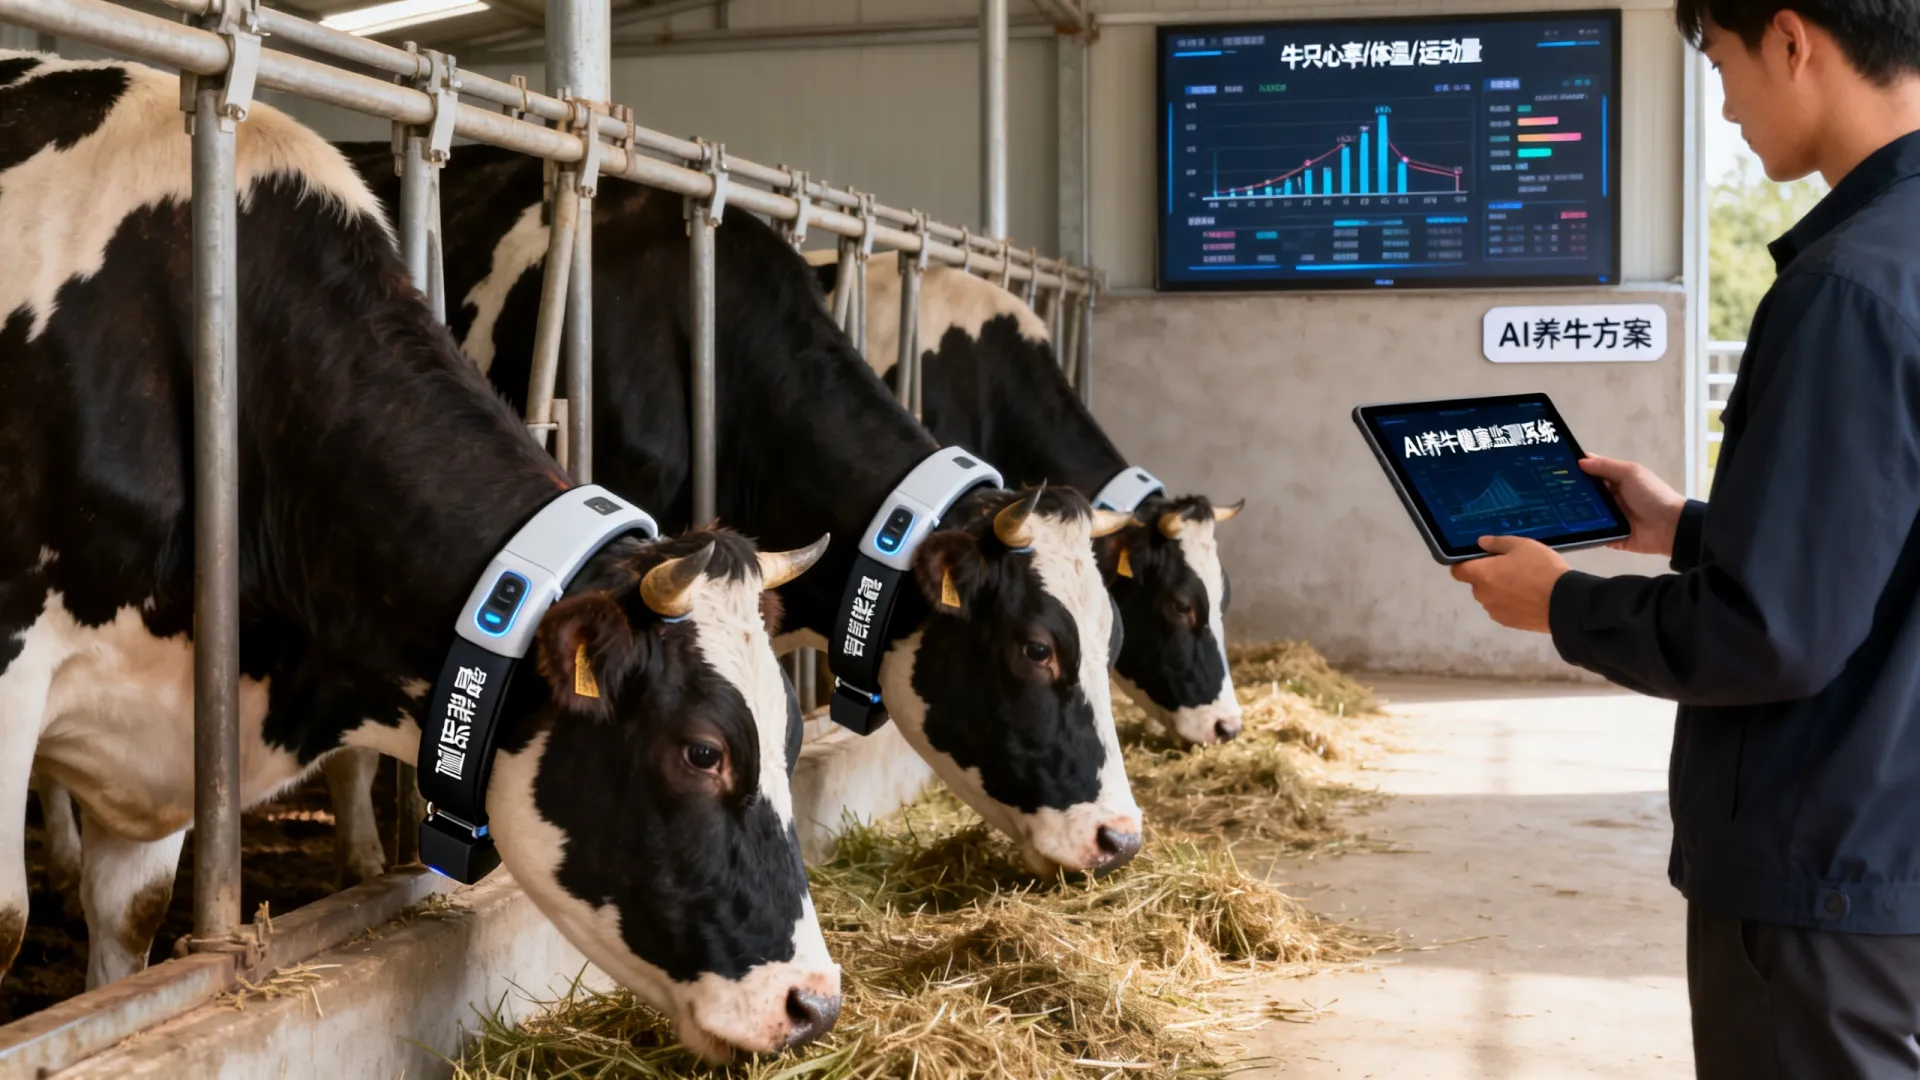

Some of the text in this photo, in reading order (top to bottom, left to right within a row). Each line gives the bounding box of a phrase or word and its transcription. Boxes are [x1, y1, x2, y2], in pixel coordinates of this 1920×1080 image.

[1281, 38, 1482, 70] 牛只心率/体温/运动量
[1498, 317, 1652, 350] AI养牛方案
